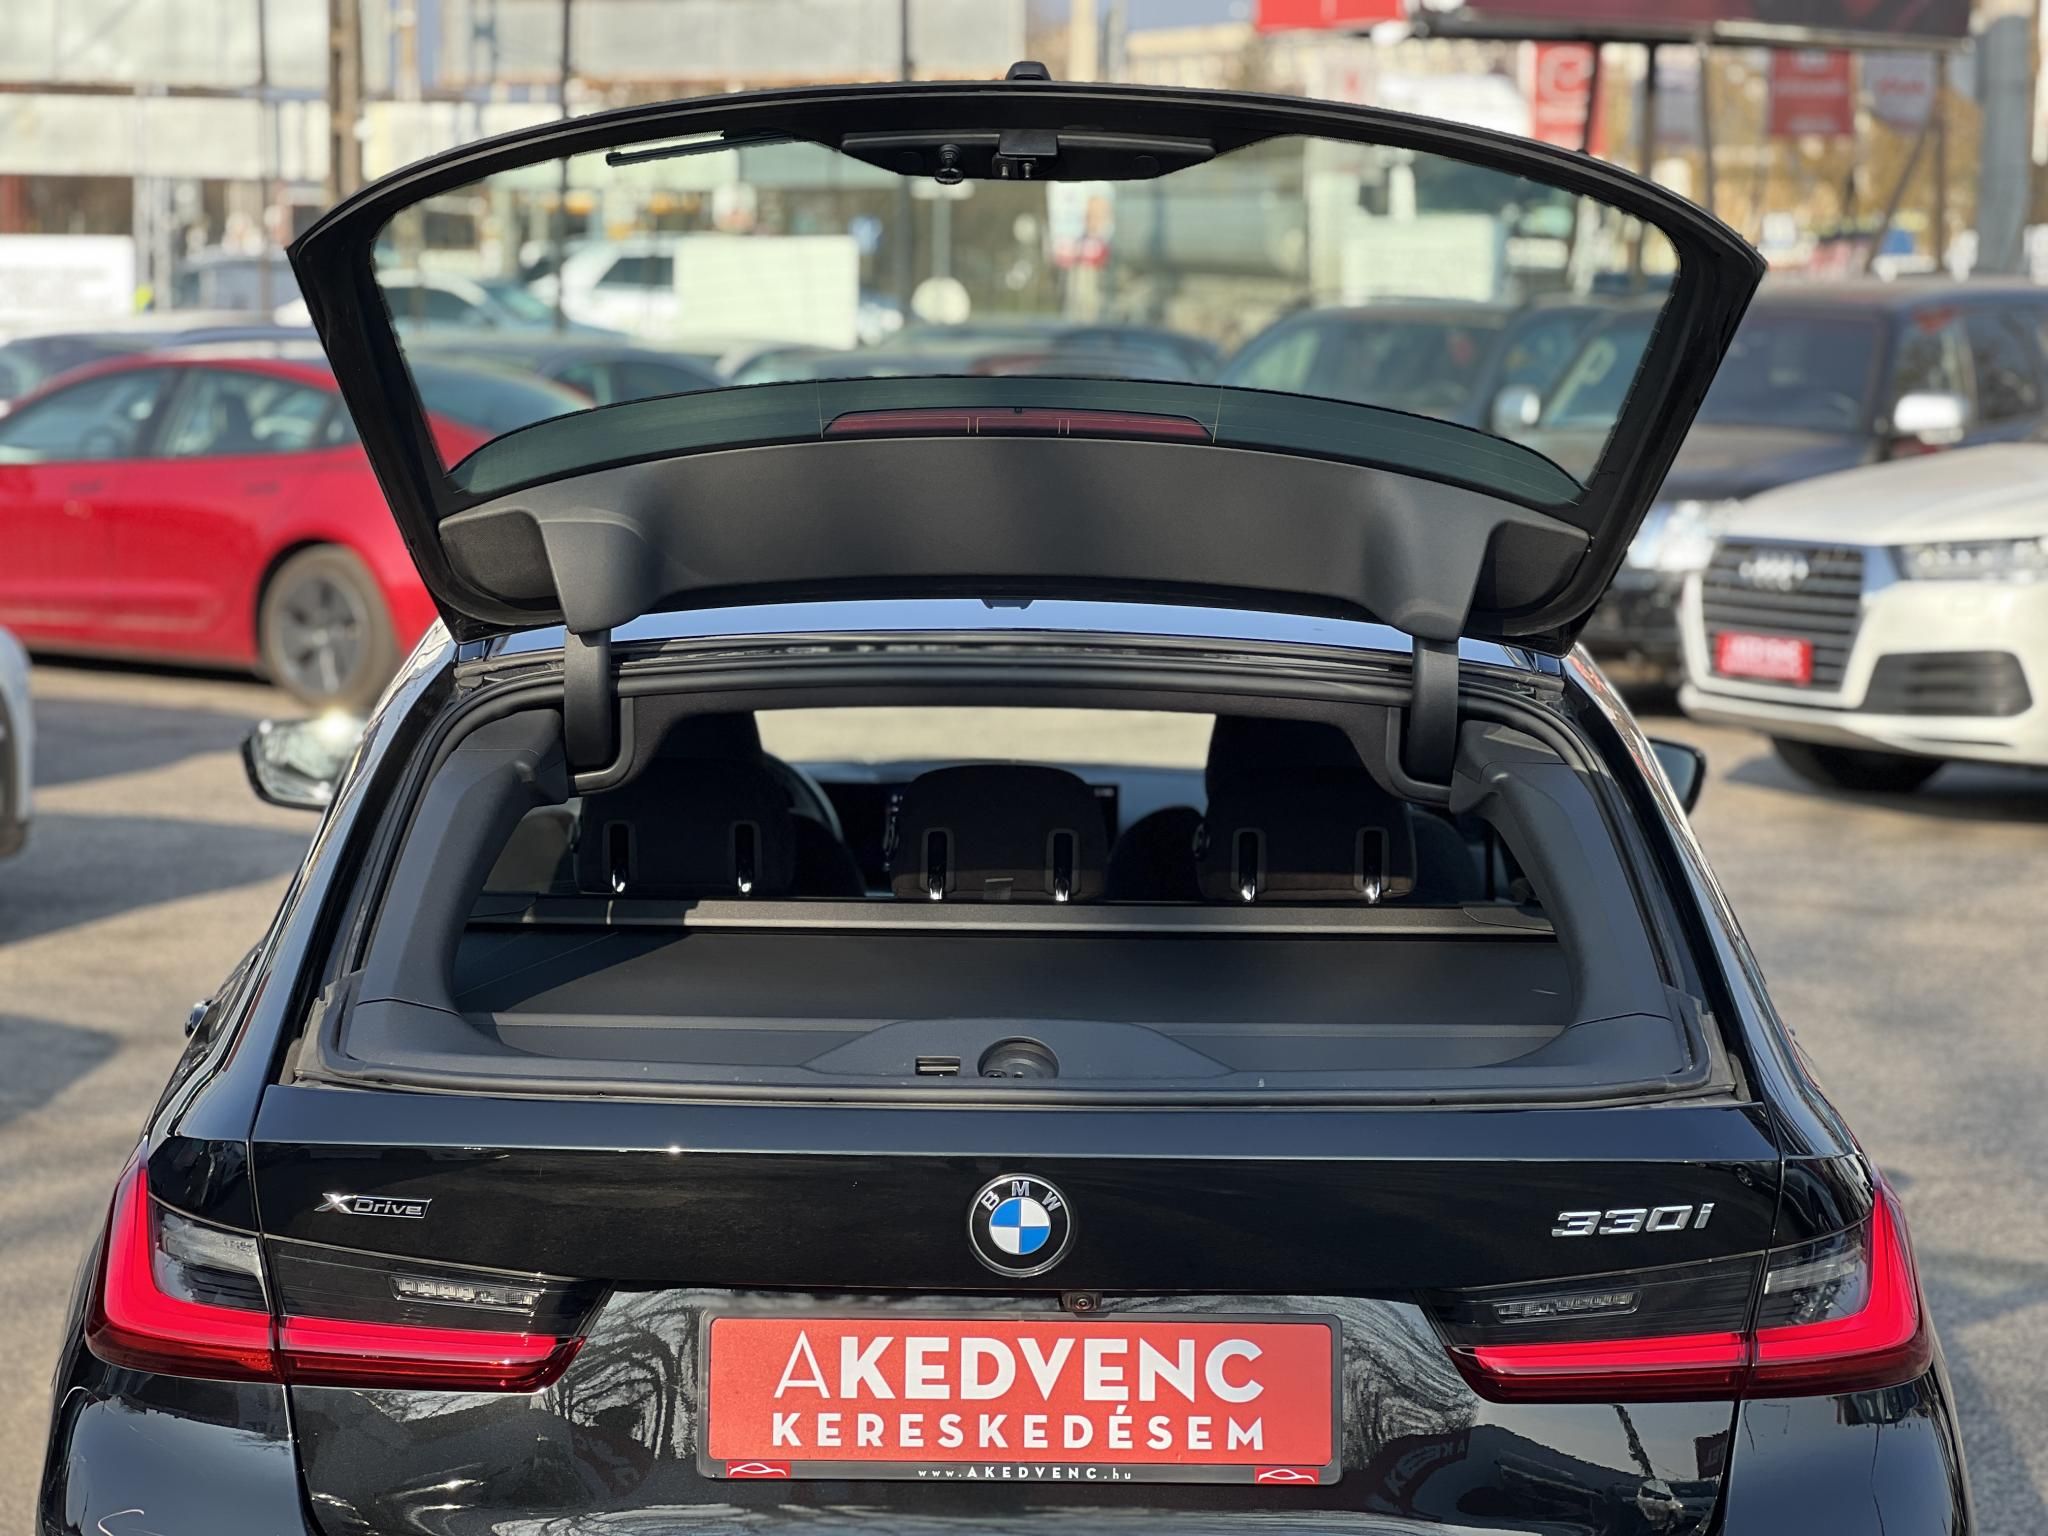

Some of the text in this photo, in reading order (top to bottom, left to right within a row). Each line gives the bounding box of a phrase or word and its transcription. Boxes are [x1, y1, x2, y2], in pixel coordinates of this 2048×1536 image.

[981, 1181, 1061, 1211] BMW
[1552, 1203, 1715, 1237] 330i
[772, 1405, 1264, 1451] KERESKEDÉSEM
[918, 1466, 1132, 1480] www.AKEDVENC.hu
